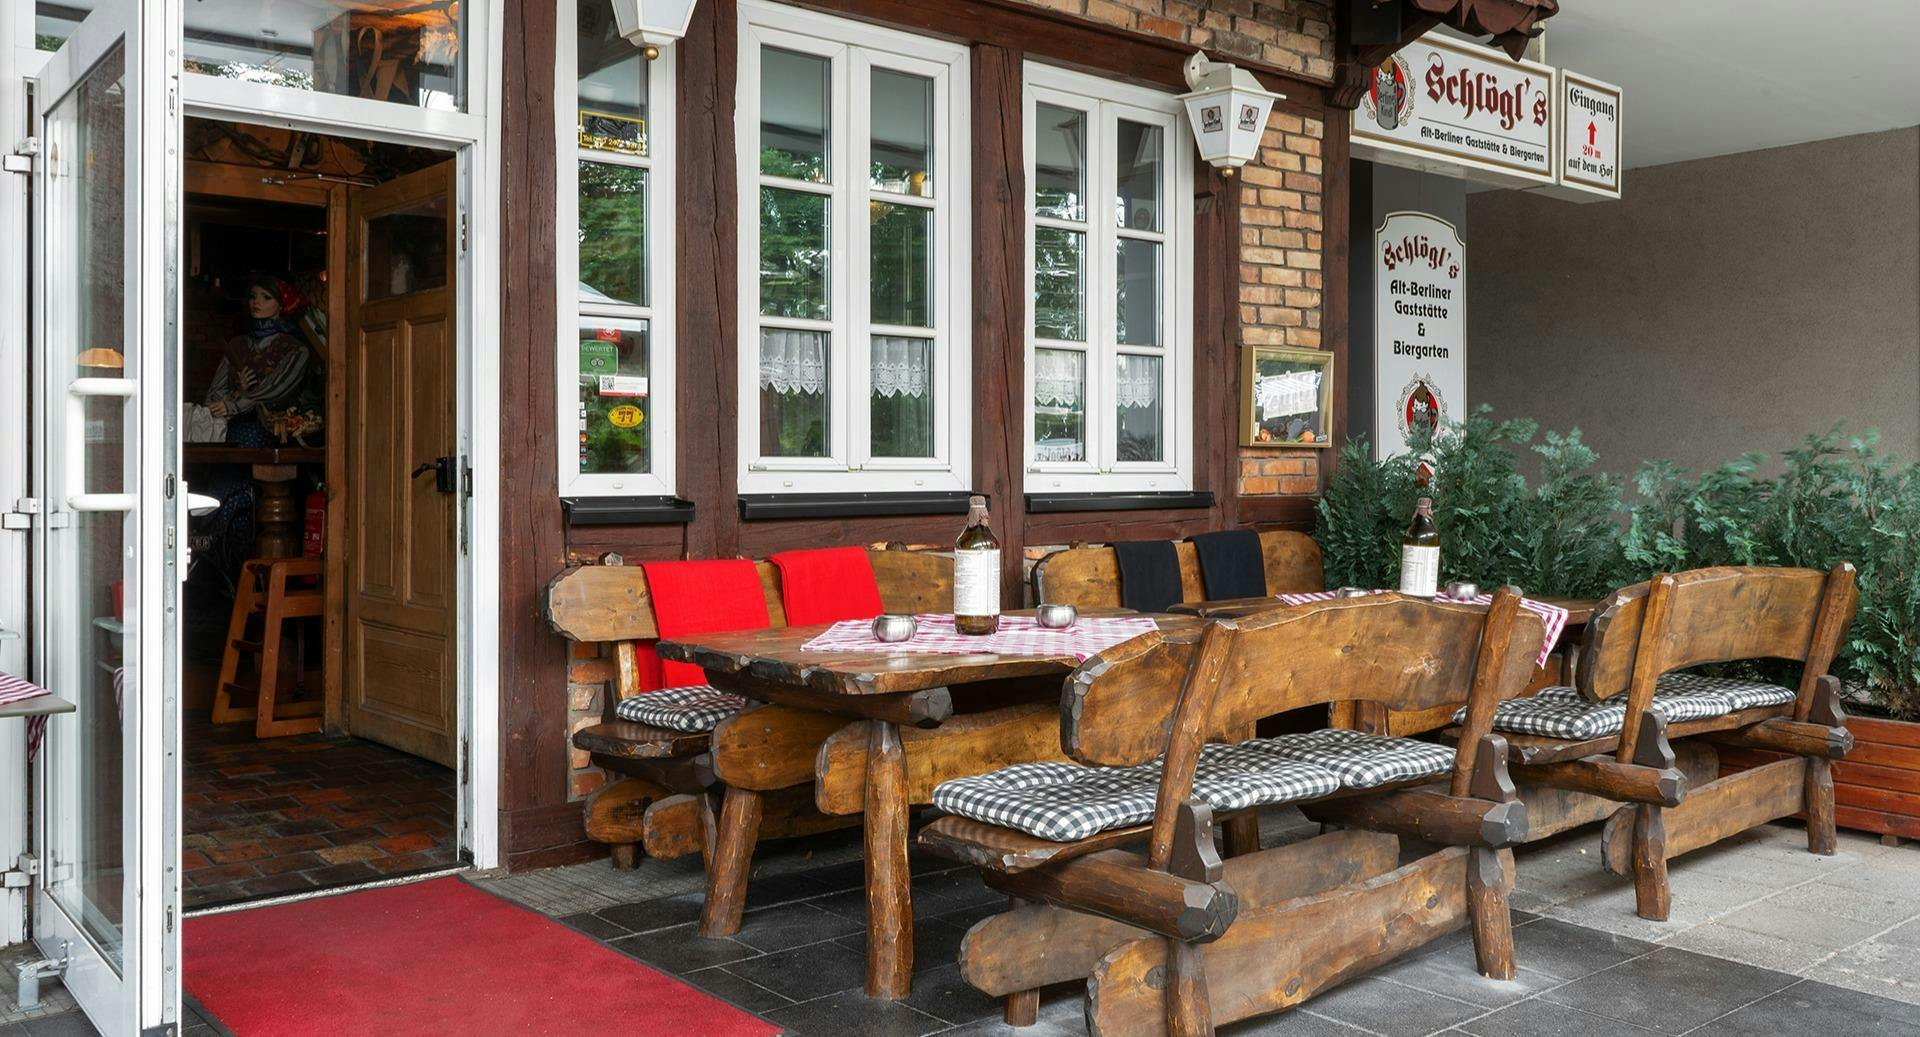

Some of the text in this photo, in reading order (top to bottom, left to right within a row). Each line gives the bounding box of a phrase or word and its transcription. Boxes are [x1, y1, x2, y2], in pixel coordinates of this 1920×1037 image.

[1425, 51, 1547, 131] Schlögl's
[1569, 87, 1615, 122] Eingang
[1420, 126, 1545, 162] Alt-Berliner Gaststätte & Biergarten
[1583, 144, 1594, 157] 20
[1568, 157, 1614, 180] auf dem Hof
[1382, 235, 1460, 279] Schlögl's
[1390, 279, 1452, 300] Alt-Berliner
[1394, 300, 1448, 319] Gaststätte
[1417, 322, 1426, 337] &
[1393, 340, 1449, 360] Biergarten
[618, 410, 634, 423] 77
